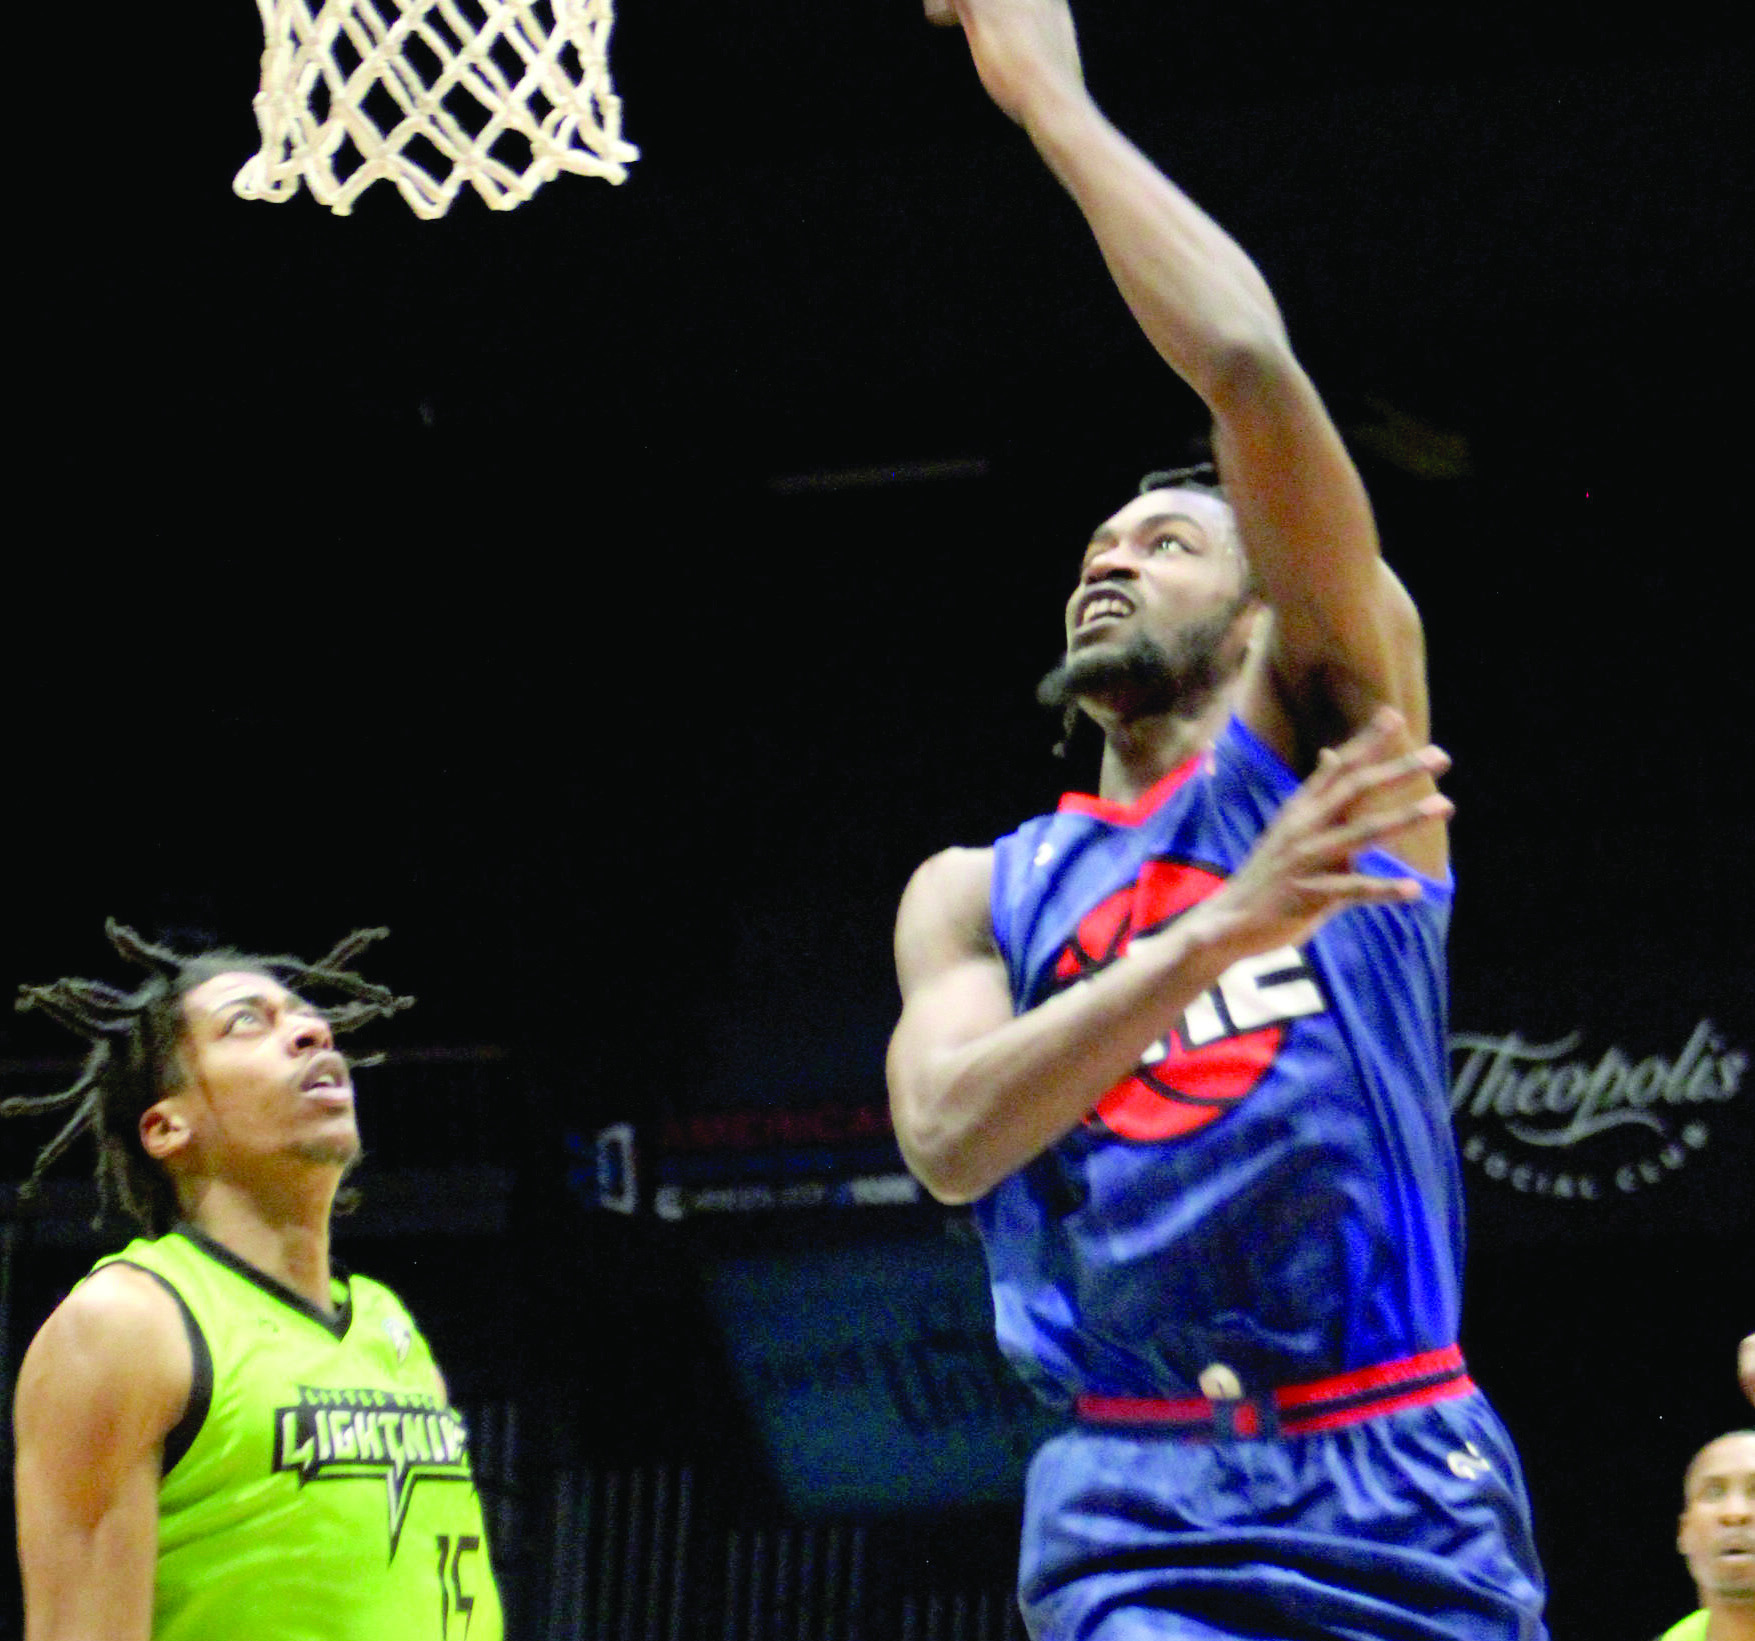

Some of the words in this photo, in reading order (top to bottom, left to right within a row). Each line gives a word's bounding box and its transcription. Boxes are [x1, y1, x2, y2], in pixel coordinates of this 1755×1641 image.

[1447, 1018, 1748, 1147] Theopolis
[1464, 1136, 1600, 1200] SOCIAL
[1614, 1119, 1710, 1193] CLUB
